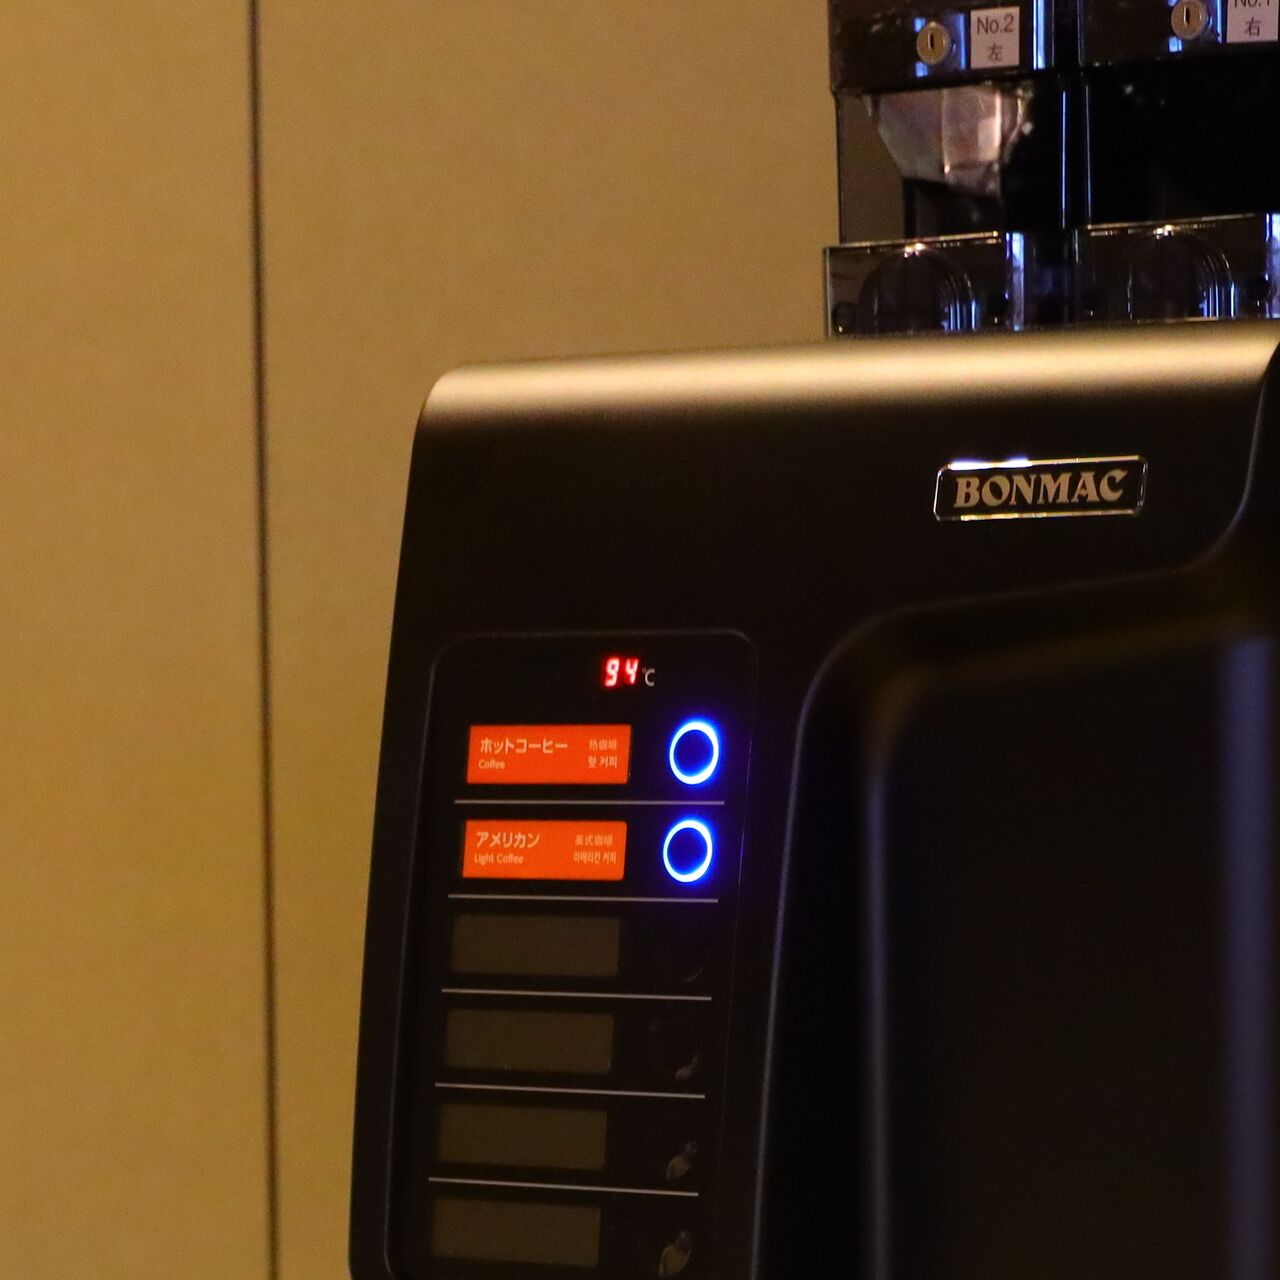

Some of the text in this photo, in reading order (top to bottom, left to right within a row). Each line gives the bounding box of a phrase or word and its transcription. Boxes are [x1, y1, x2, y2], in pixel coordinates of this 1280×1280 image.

[1234, 0, 1270, 8] o.
[976, 13, 1014, 34] No.2
[1244, 17, 1261, 37] 右
[987, 42, 1003, 62] 左
[953, 468, 1127, 508] BONMAC
[605, 658, 639, 687] 94
[480, 737, 568, 755] ホットコーヒー
[478, 759, 506, 770] Coffee
[476, 831, 540, 849] アメリカン
[474, 852, 524, 866] Light Coffee
